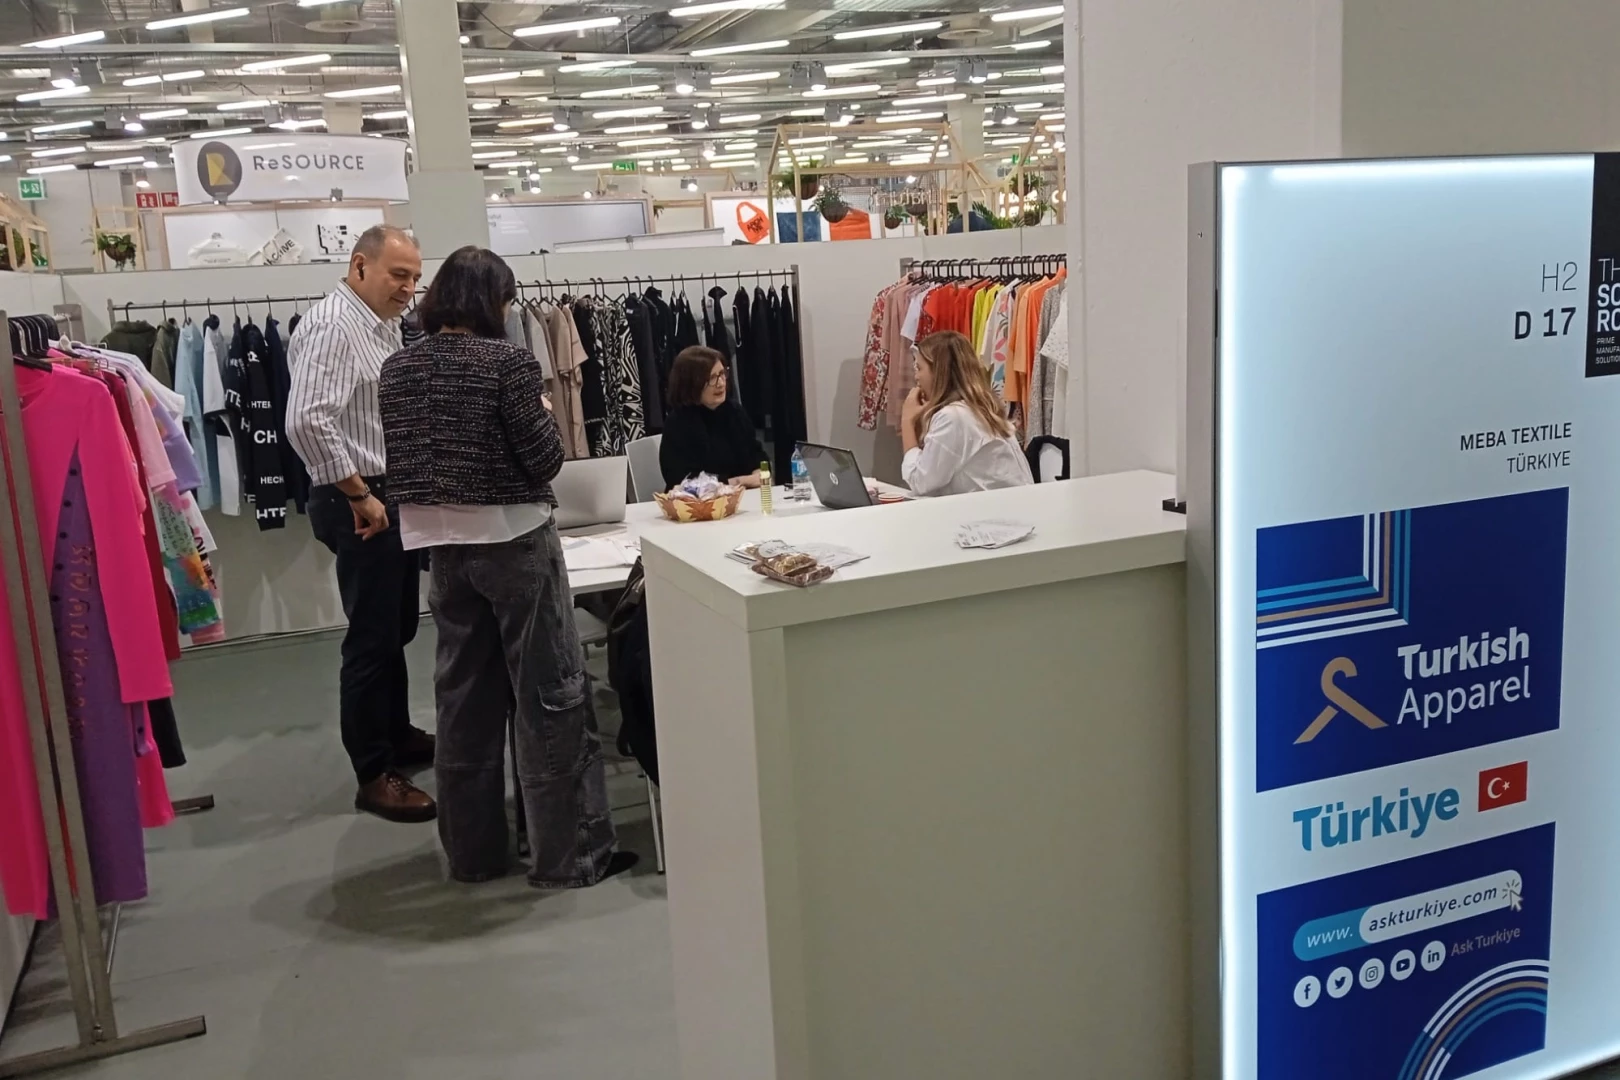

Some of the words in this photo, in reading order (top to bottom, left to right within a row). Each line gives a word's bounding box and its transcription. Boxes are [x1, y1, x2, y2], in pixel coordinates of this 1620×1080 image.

[253, 155, 364, 170] ReSOURCE
[1542, 261, 1578, 292] H2
[1514, 311, 1531, 340] D
[1543, 307, 1576, 337] 17
[1460, 430, 1507, 451] MEBA
[1511, 422, 1572, 444] TEXTILE
[1507, 450, 1571, 473] TÜRKIYE
[1398, 627, 1530, 680] Turkish
[1397, 665, 1531, 728] Apparel
[1293, 787, 1460, 852] Türkiye
[1307, 926, 1353, 948] www.
[1369, 886, 1497, 932] askturkiye.com
[1451, 940, 1473, 957] Ask
[1475, 927, 1521, 949] Turkiye
